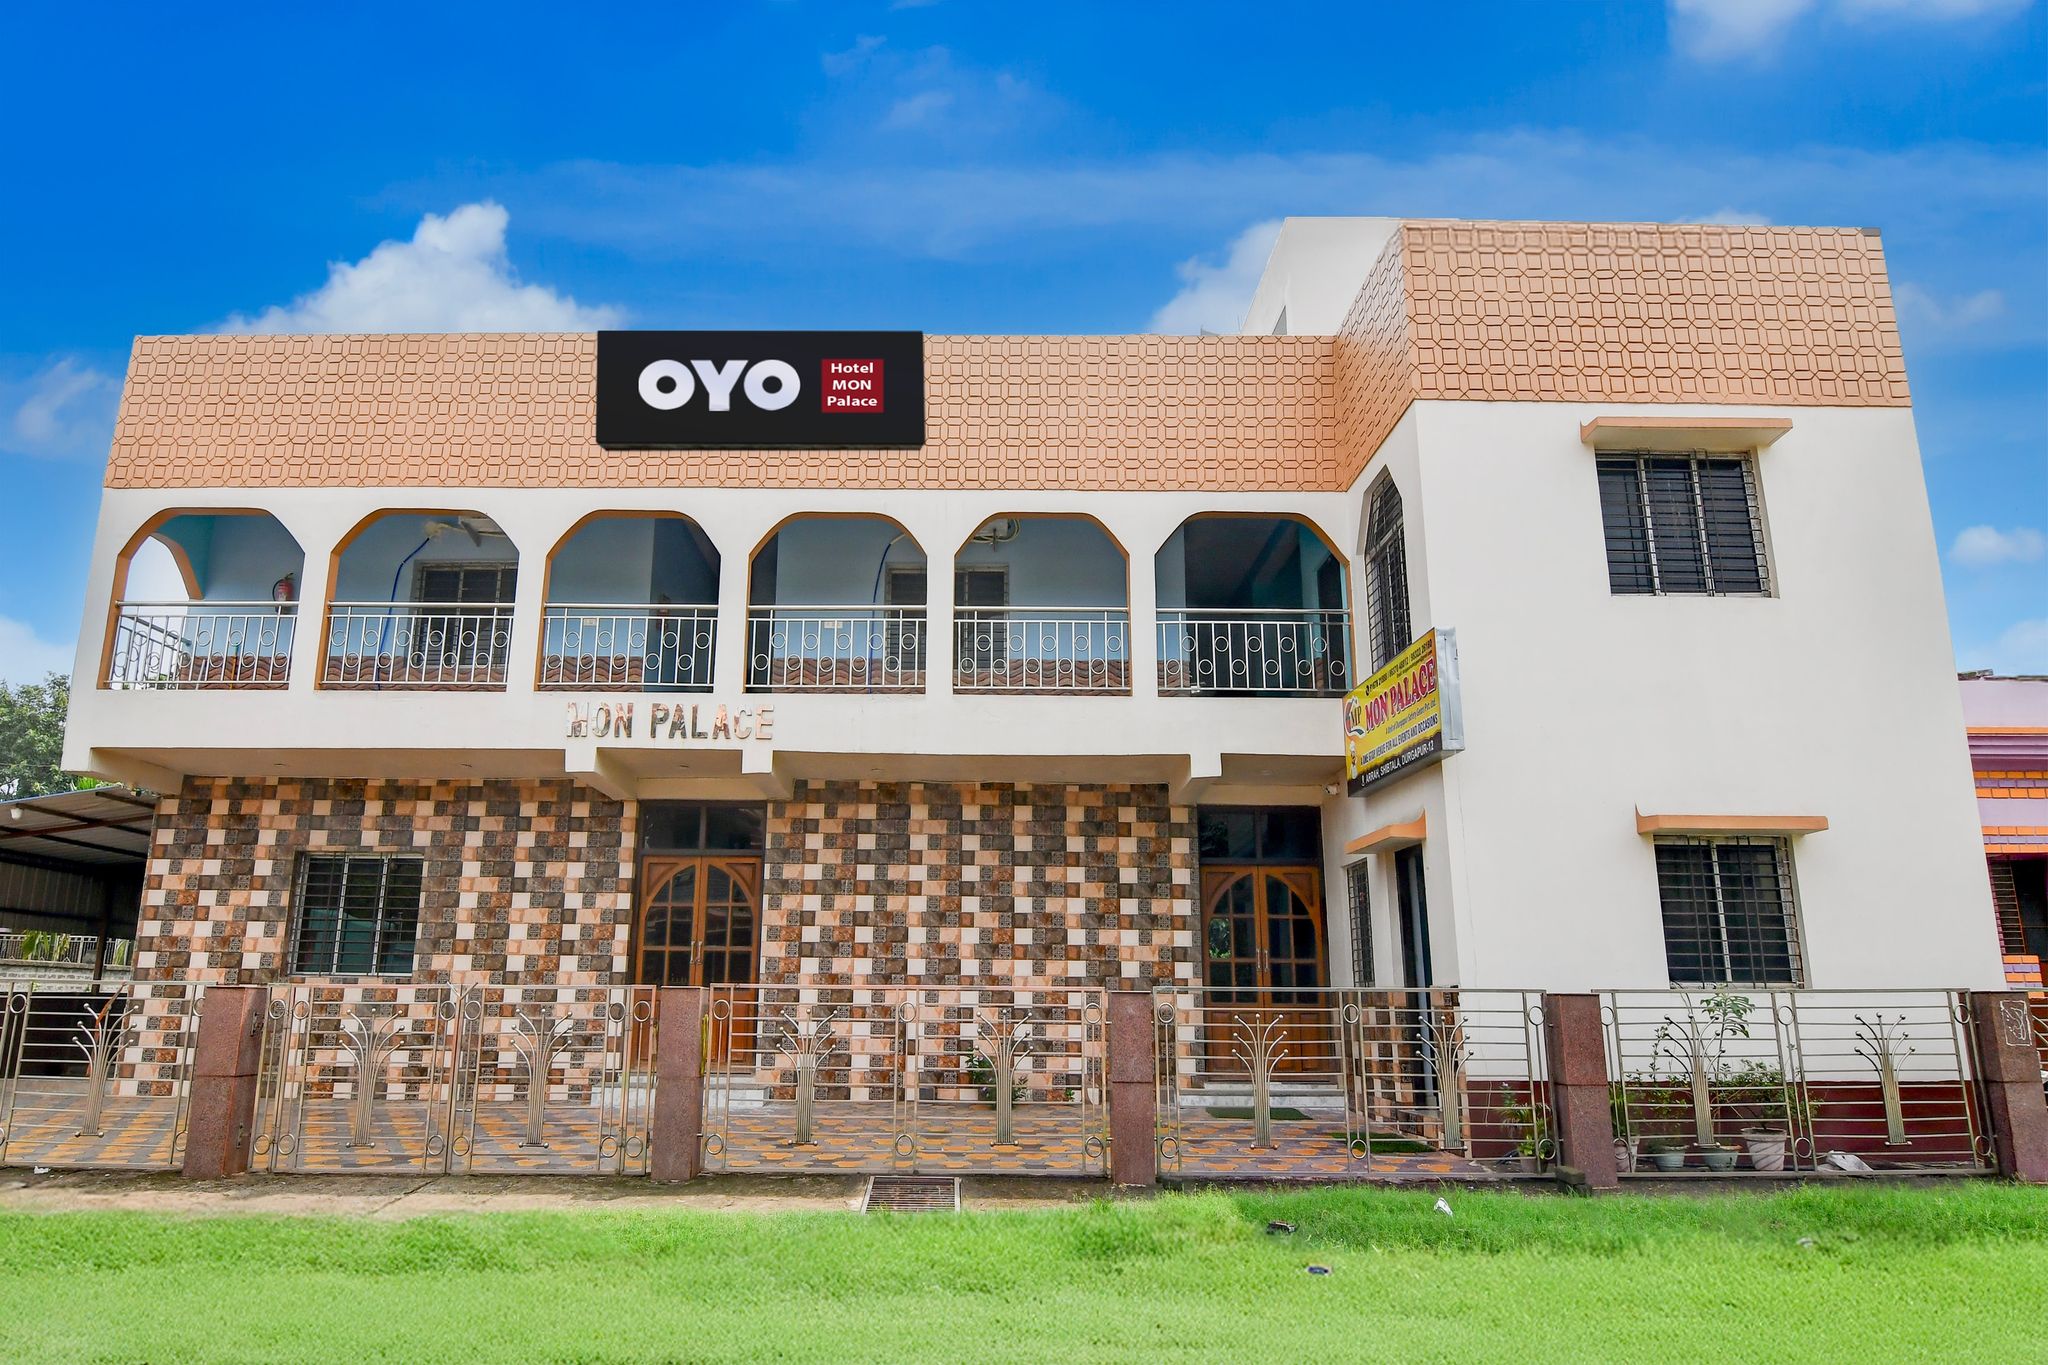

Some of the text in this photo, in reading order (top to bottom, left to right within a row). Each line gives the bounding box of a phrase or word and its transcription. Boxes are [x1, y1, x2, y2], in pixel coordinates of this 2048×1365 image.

[830, 362, 874, 374] Hotel
[638, 359, 801, 411] OYO
[832, 380, 872, 390] MON
[827, 395, 878, 407] Palace
[1365, 692, 1389, 731] MON
[1390, 659, 1436, 714] PALACE
[566, 702, 775, 740] MON PALACE
[1402, 739, 1434, 766] DURGAPUR-12
